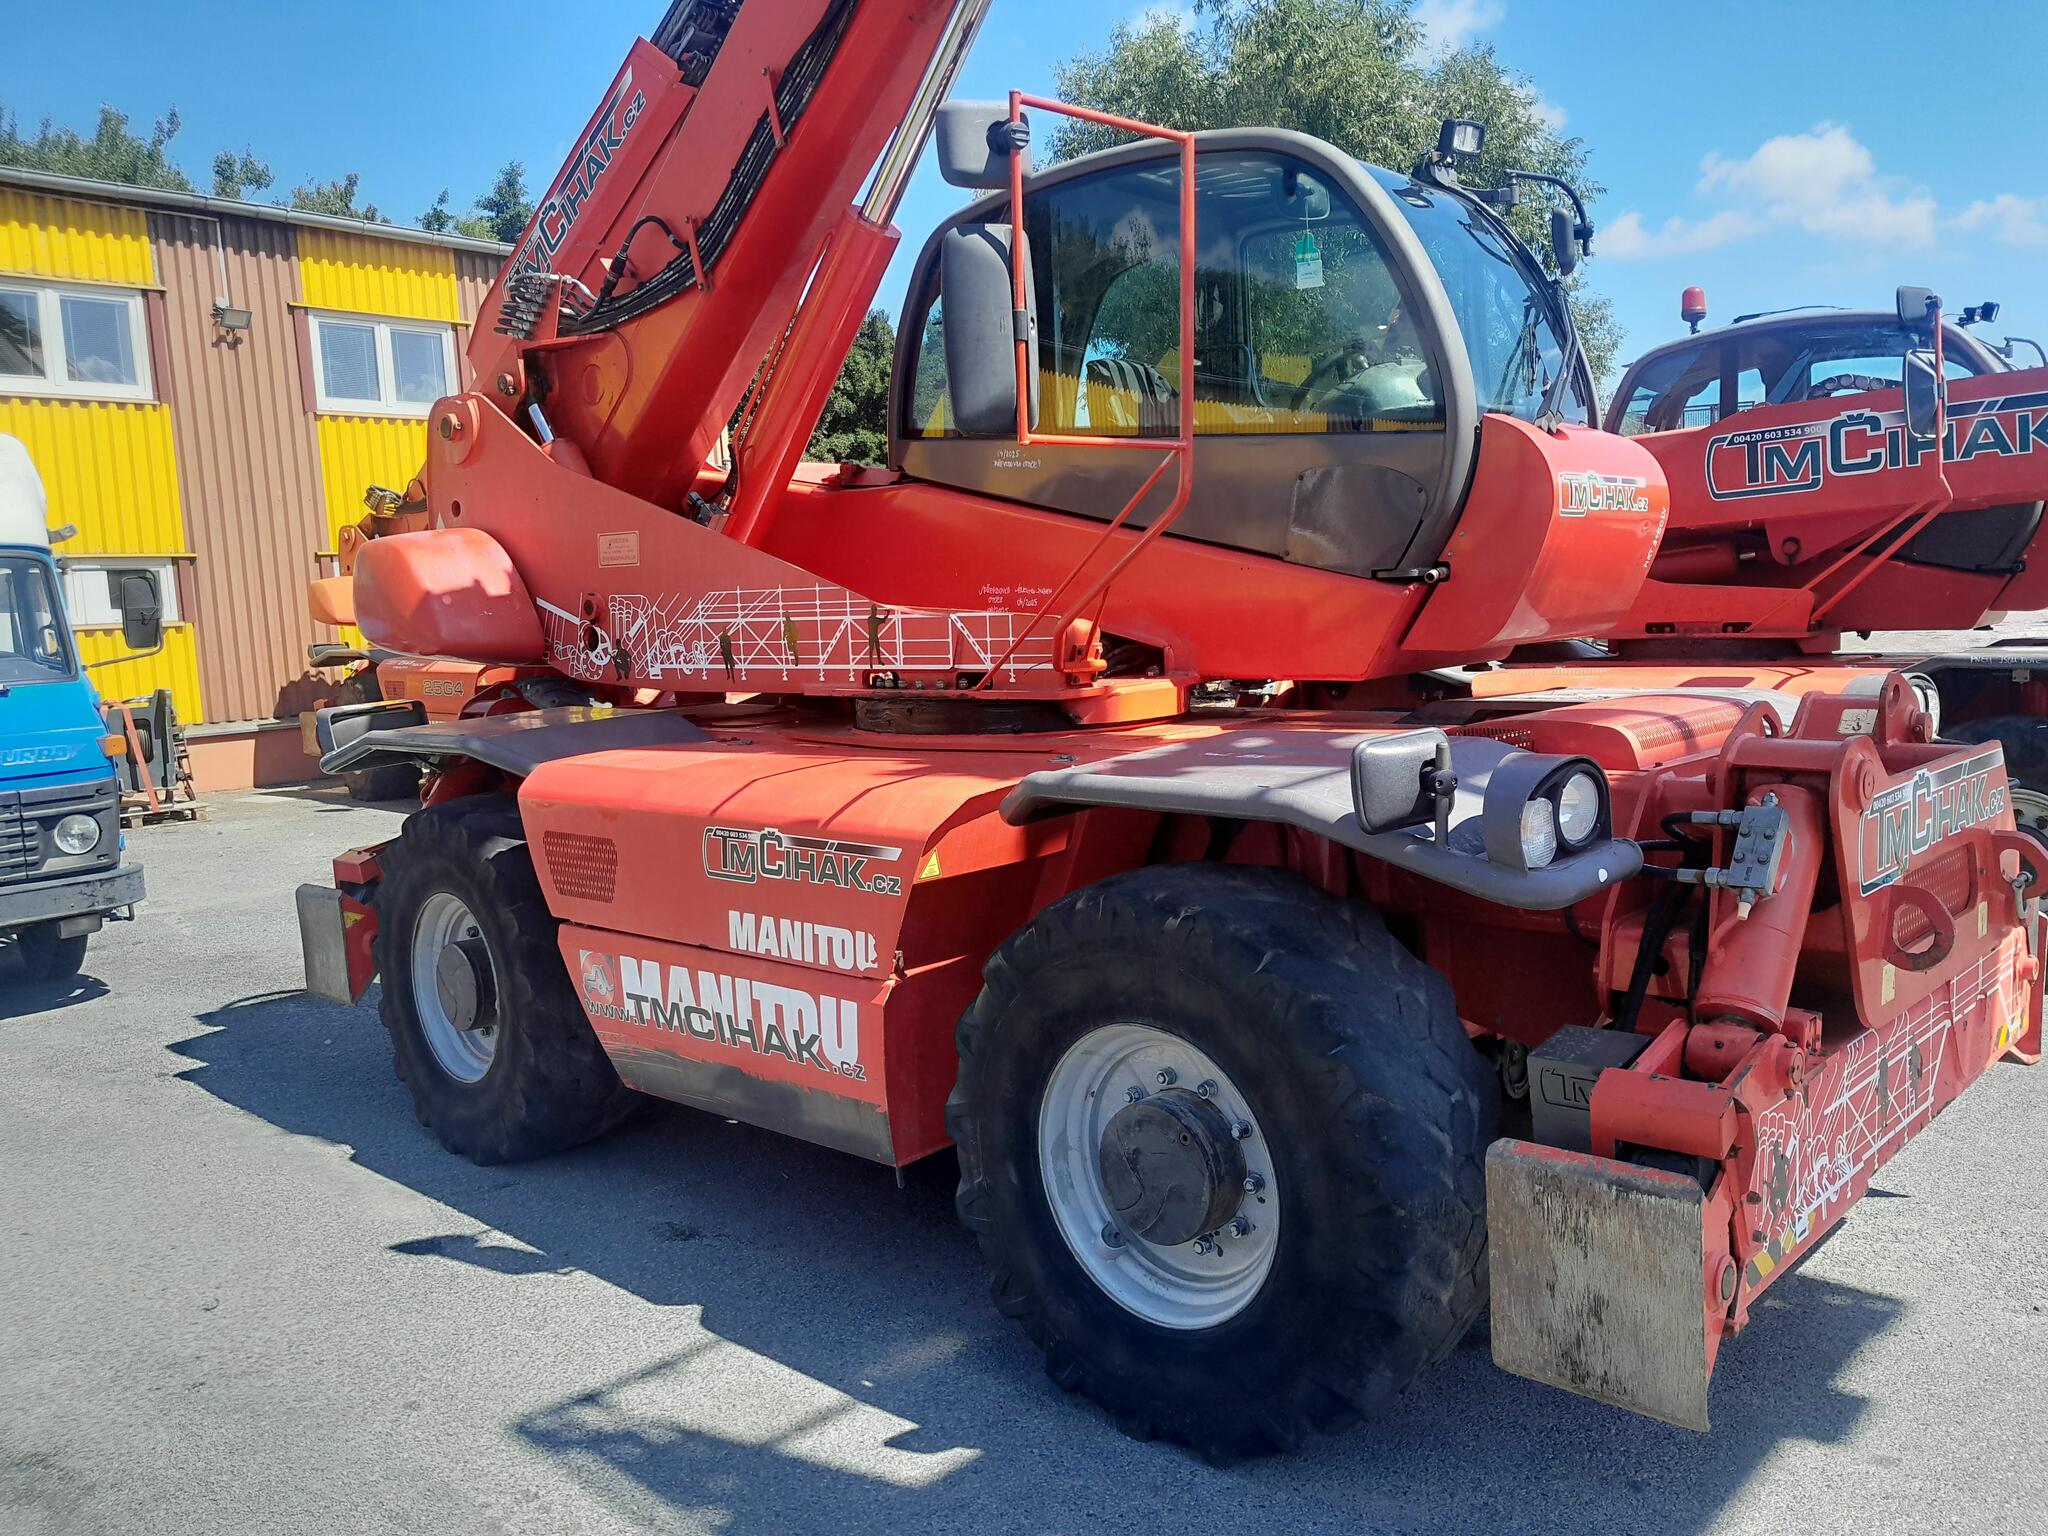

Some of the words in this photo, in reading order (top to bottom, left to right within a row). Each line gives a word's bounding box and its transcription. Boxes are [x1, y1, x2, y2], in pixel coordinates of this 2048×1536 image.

[1733, 433, 1762, 443] 00420
[1764, 430, 1782, 440] 603
[1784, 427, 1802, 437] 534
[1804, 425, 1822, 435] 900
[423, 680, 464, 696] 25G4
[728, 910, 878, 972] MANITOU
[619, 955, 859, 1066] MANITOU
